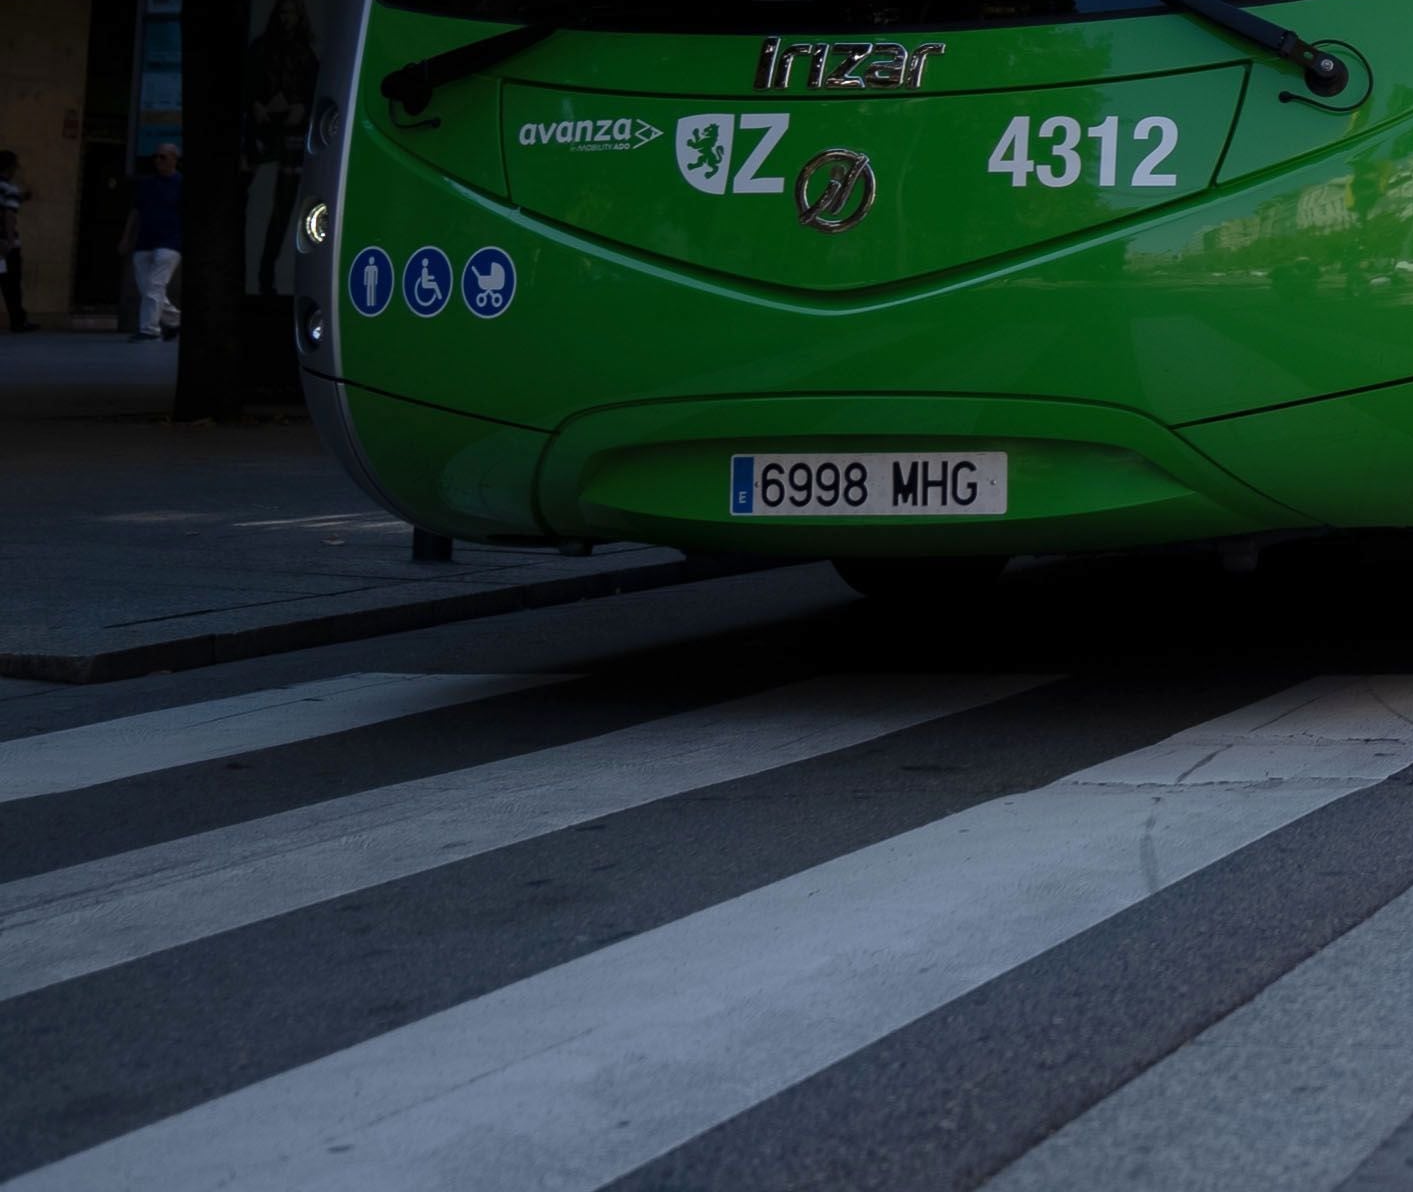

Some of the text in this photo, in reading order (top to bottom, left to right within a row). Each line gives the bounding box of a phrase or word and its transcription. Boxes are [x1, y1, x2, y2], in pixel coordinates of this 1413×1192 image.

[519, 117, 632, 146] avanza
[732, 112, 790, 194] Z
[988, 115, 1179, 188] 4312
[738, 490, 748, 504] E
[761, 461, 978, 507] 6998 MHG
